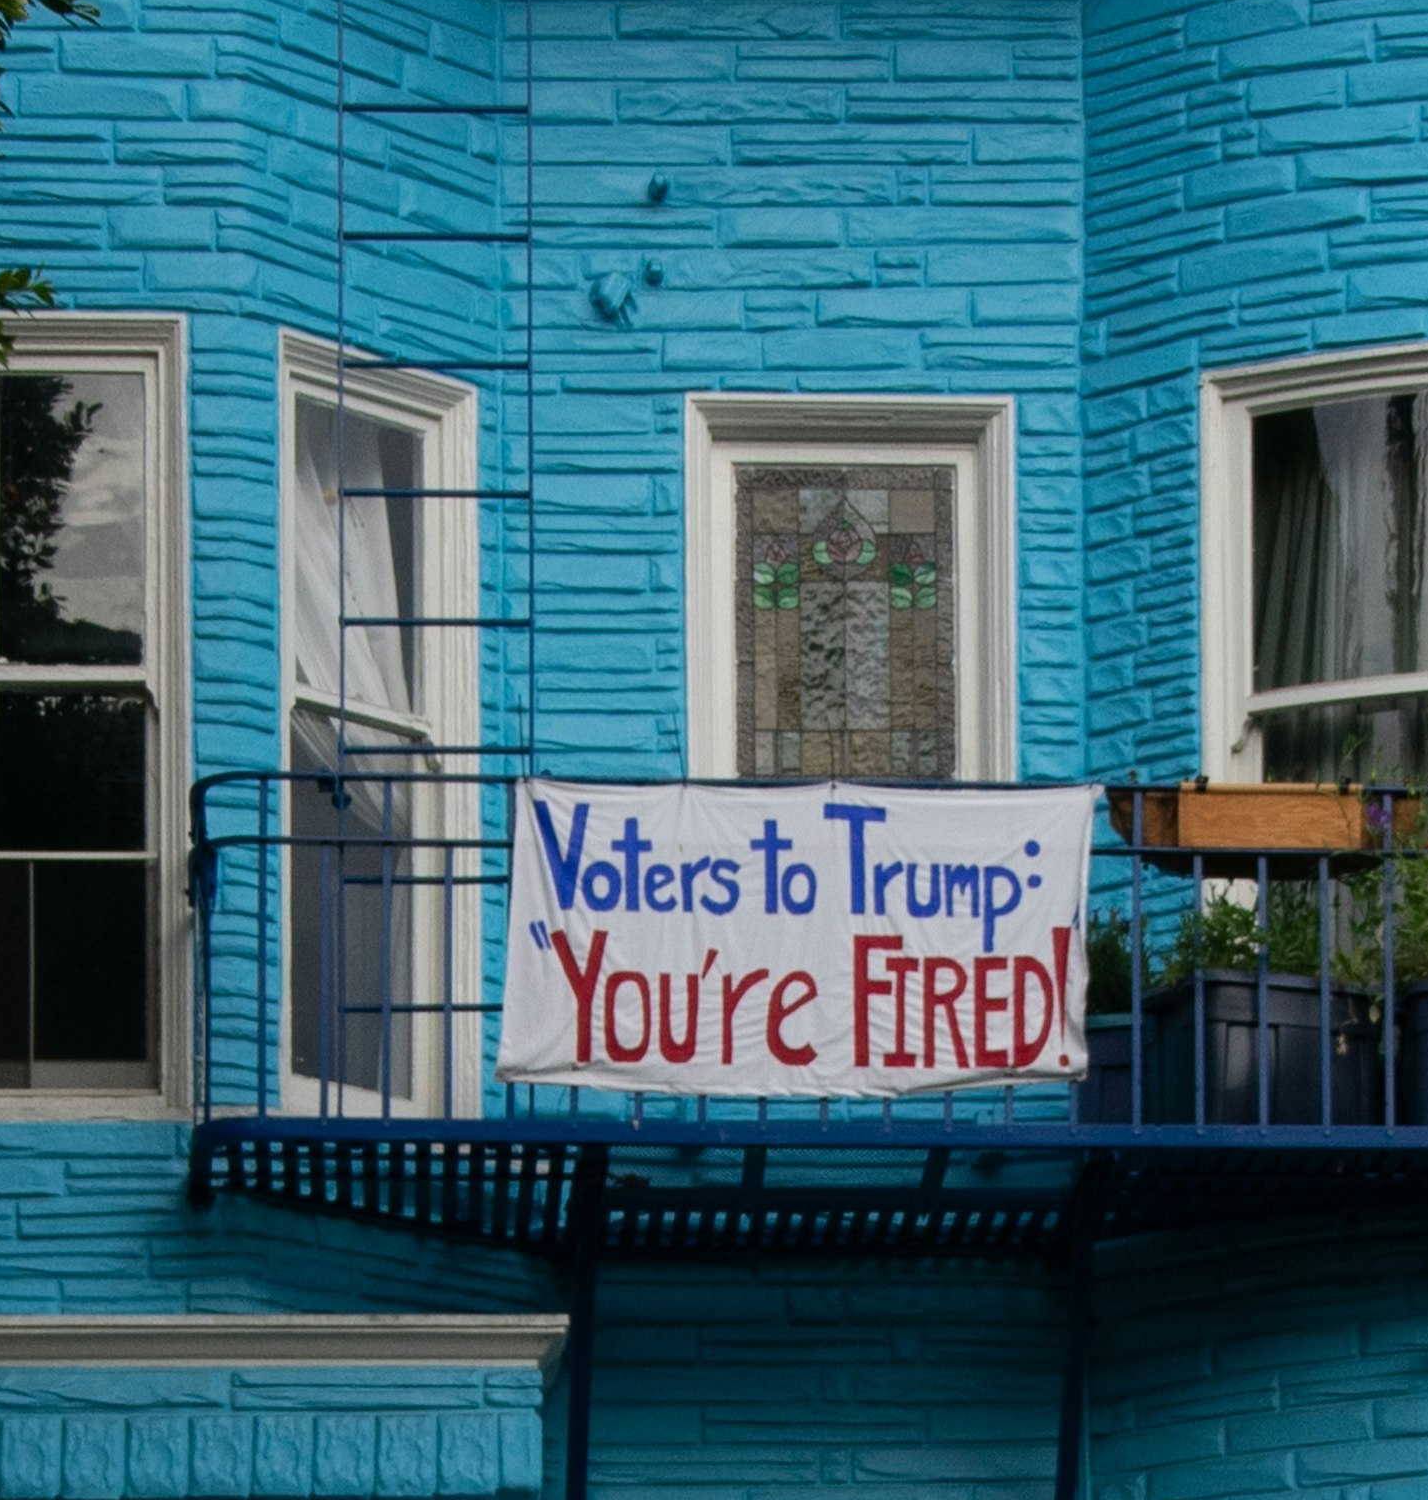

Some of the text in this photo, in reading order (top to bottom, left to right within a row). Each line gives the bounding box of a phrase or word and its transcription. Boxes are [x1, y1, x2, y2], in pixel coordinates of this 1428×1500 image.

[533, 800, 1043, 953] Voters to Trump:
[528, 920, 819, 1067] "You're
